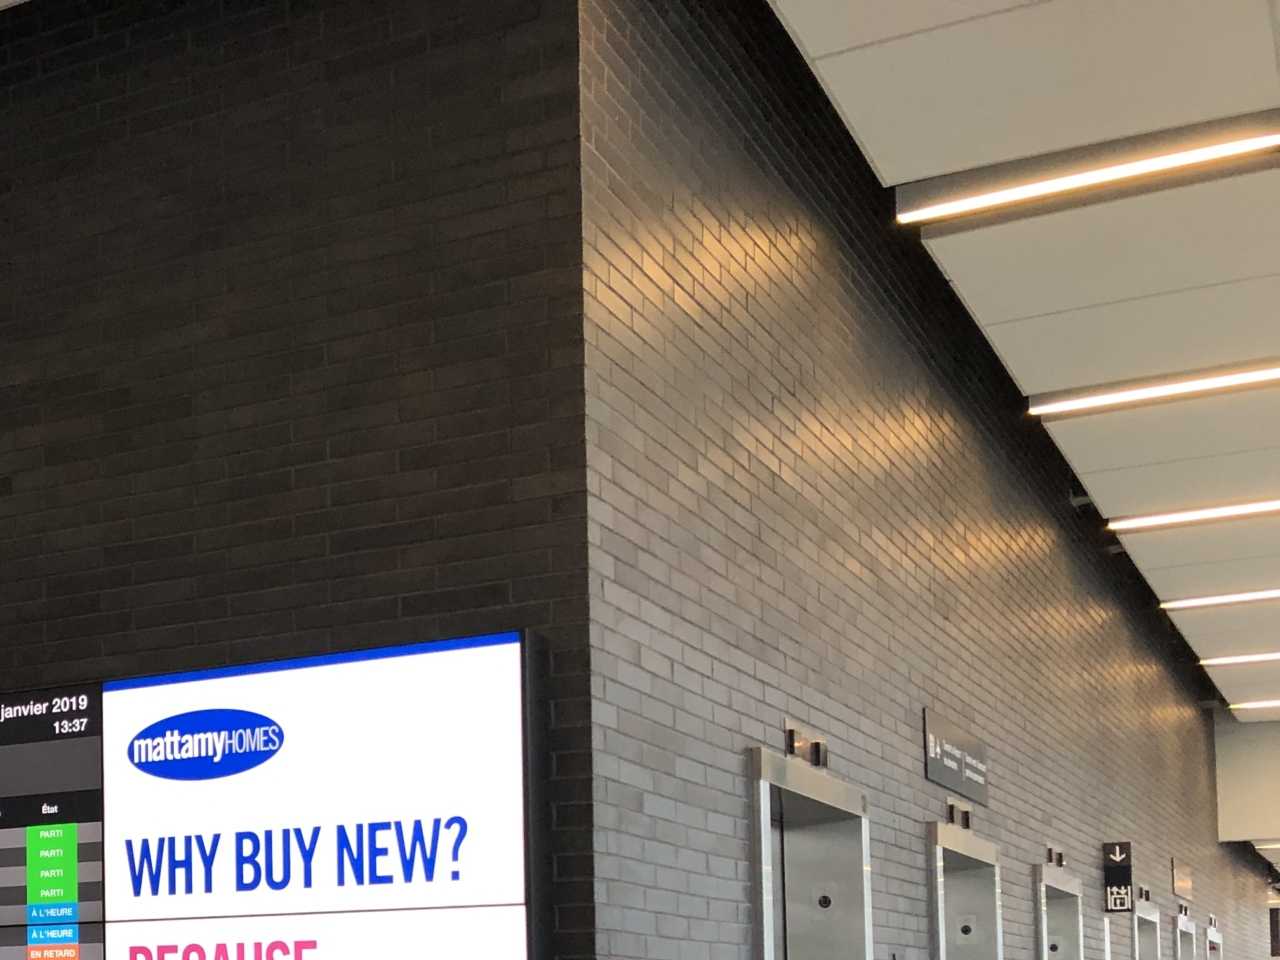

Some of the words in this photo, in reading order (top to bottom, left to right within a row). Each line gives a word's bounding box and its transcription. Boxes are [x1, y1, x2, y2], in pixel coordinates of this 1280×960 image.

[0, 701, 49, 722] janvier
[52, 695, 87, 712] 2019
[54, 718, 88, 733] 13:37
[133, 725, 280, 764] mattamyHOMES
[42, 803, 58, 814] État
[40, 830, 62, 838] PARTI
[40, 849, 63, 857] PARTI
[125, 833, 221, 897] WHY
[234, 826, 322, 892] BUY
[336, 816, 468, 887] NEW?
[40, 869, 63, 877] PARTI
[32, 930, 37, 938] À
[40, 929, 73, 938] L'HEURE
[44, 949, 75, 958] RETARD
